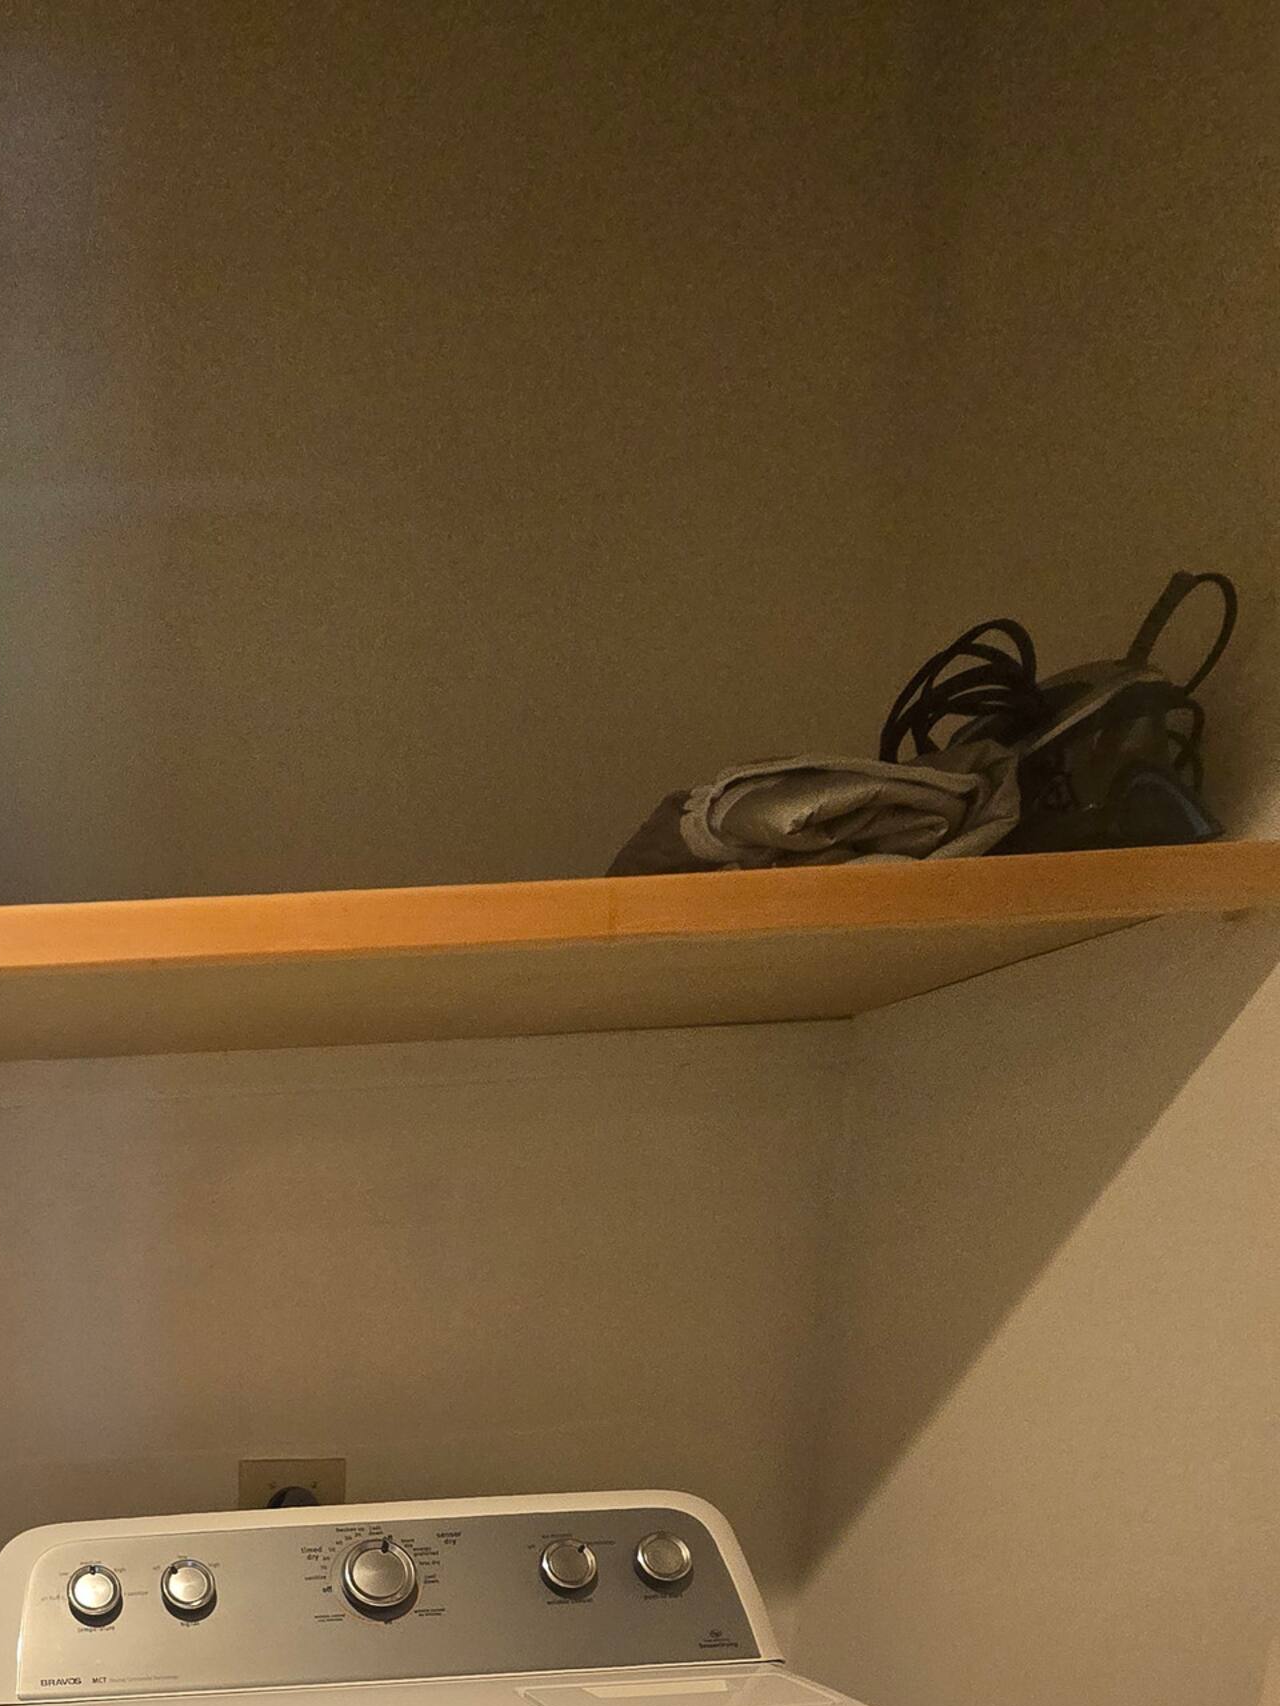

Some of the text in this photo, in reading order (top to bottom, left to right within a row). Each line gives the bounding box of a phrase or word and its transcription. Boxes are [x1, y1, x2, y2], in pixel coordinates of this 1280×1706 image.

[300, 1546, 323, 1554] timed
[307, 1553, 319, 1561] dry
[40, 1677, 82, 1687] BRAVOS
[91, 1676, 107, 1684] MCT
